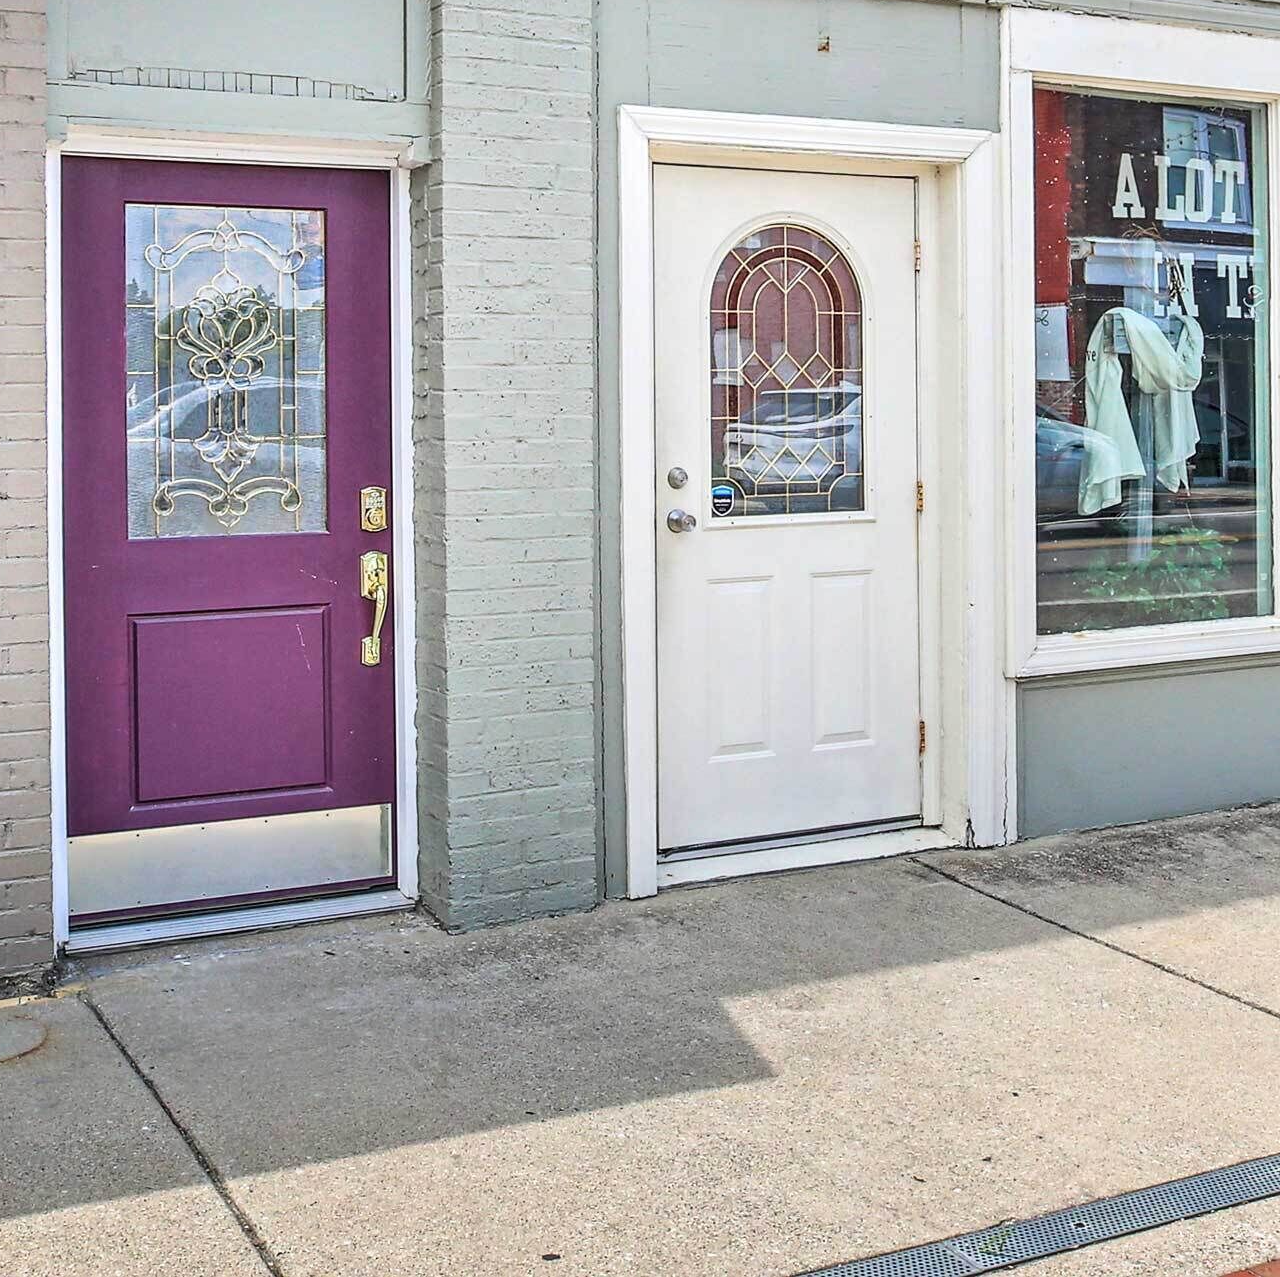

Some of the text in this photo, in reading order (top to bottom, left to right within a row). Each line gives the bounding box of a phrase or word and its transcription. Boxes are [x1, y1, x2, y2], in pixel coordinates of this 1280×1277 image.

[1112, 153, 1146, 219] A
[1154, 155, 1245, 223] LOT
[1153, 251, 1199, 318] IN
